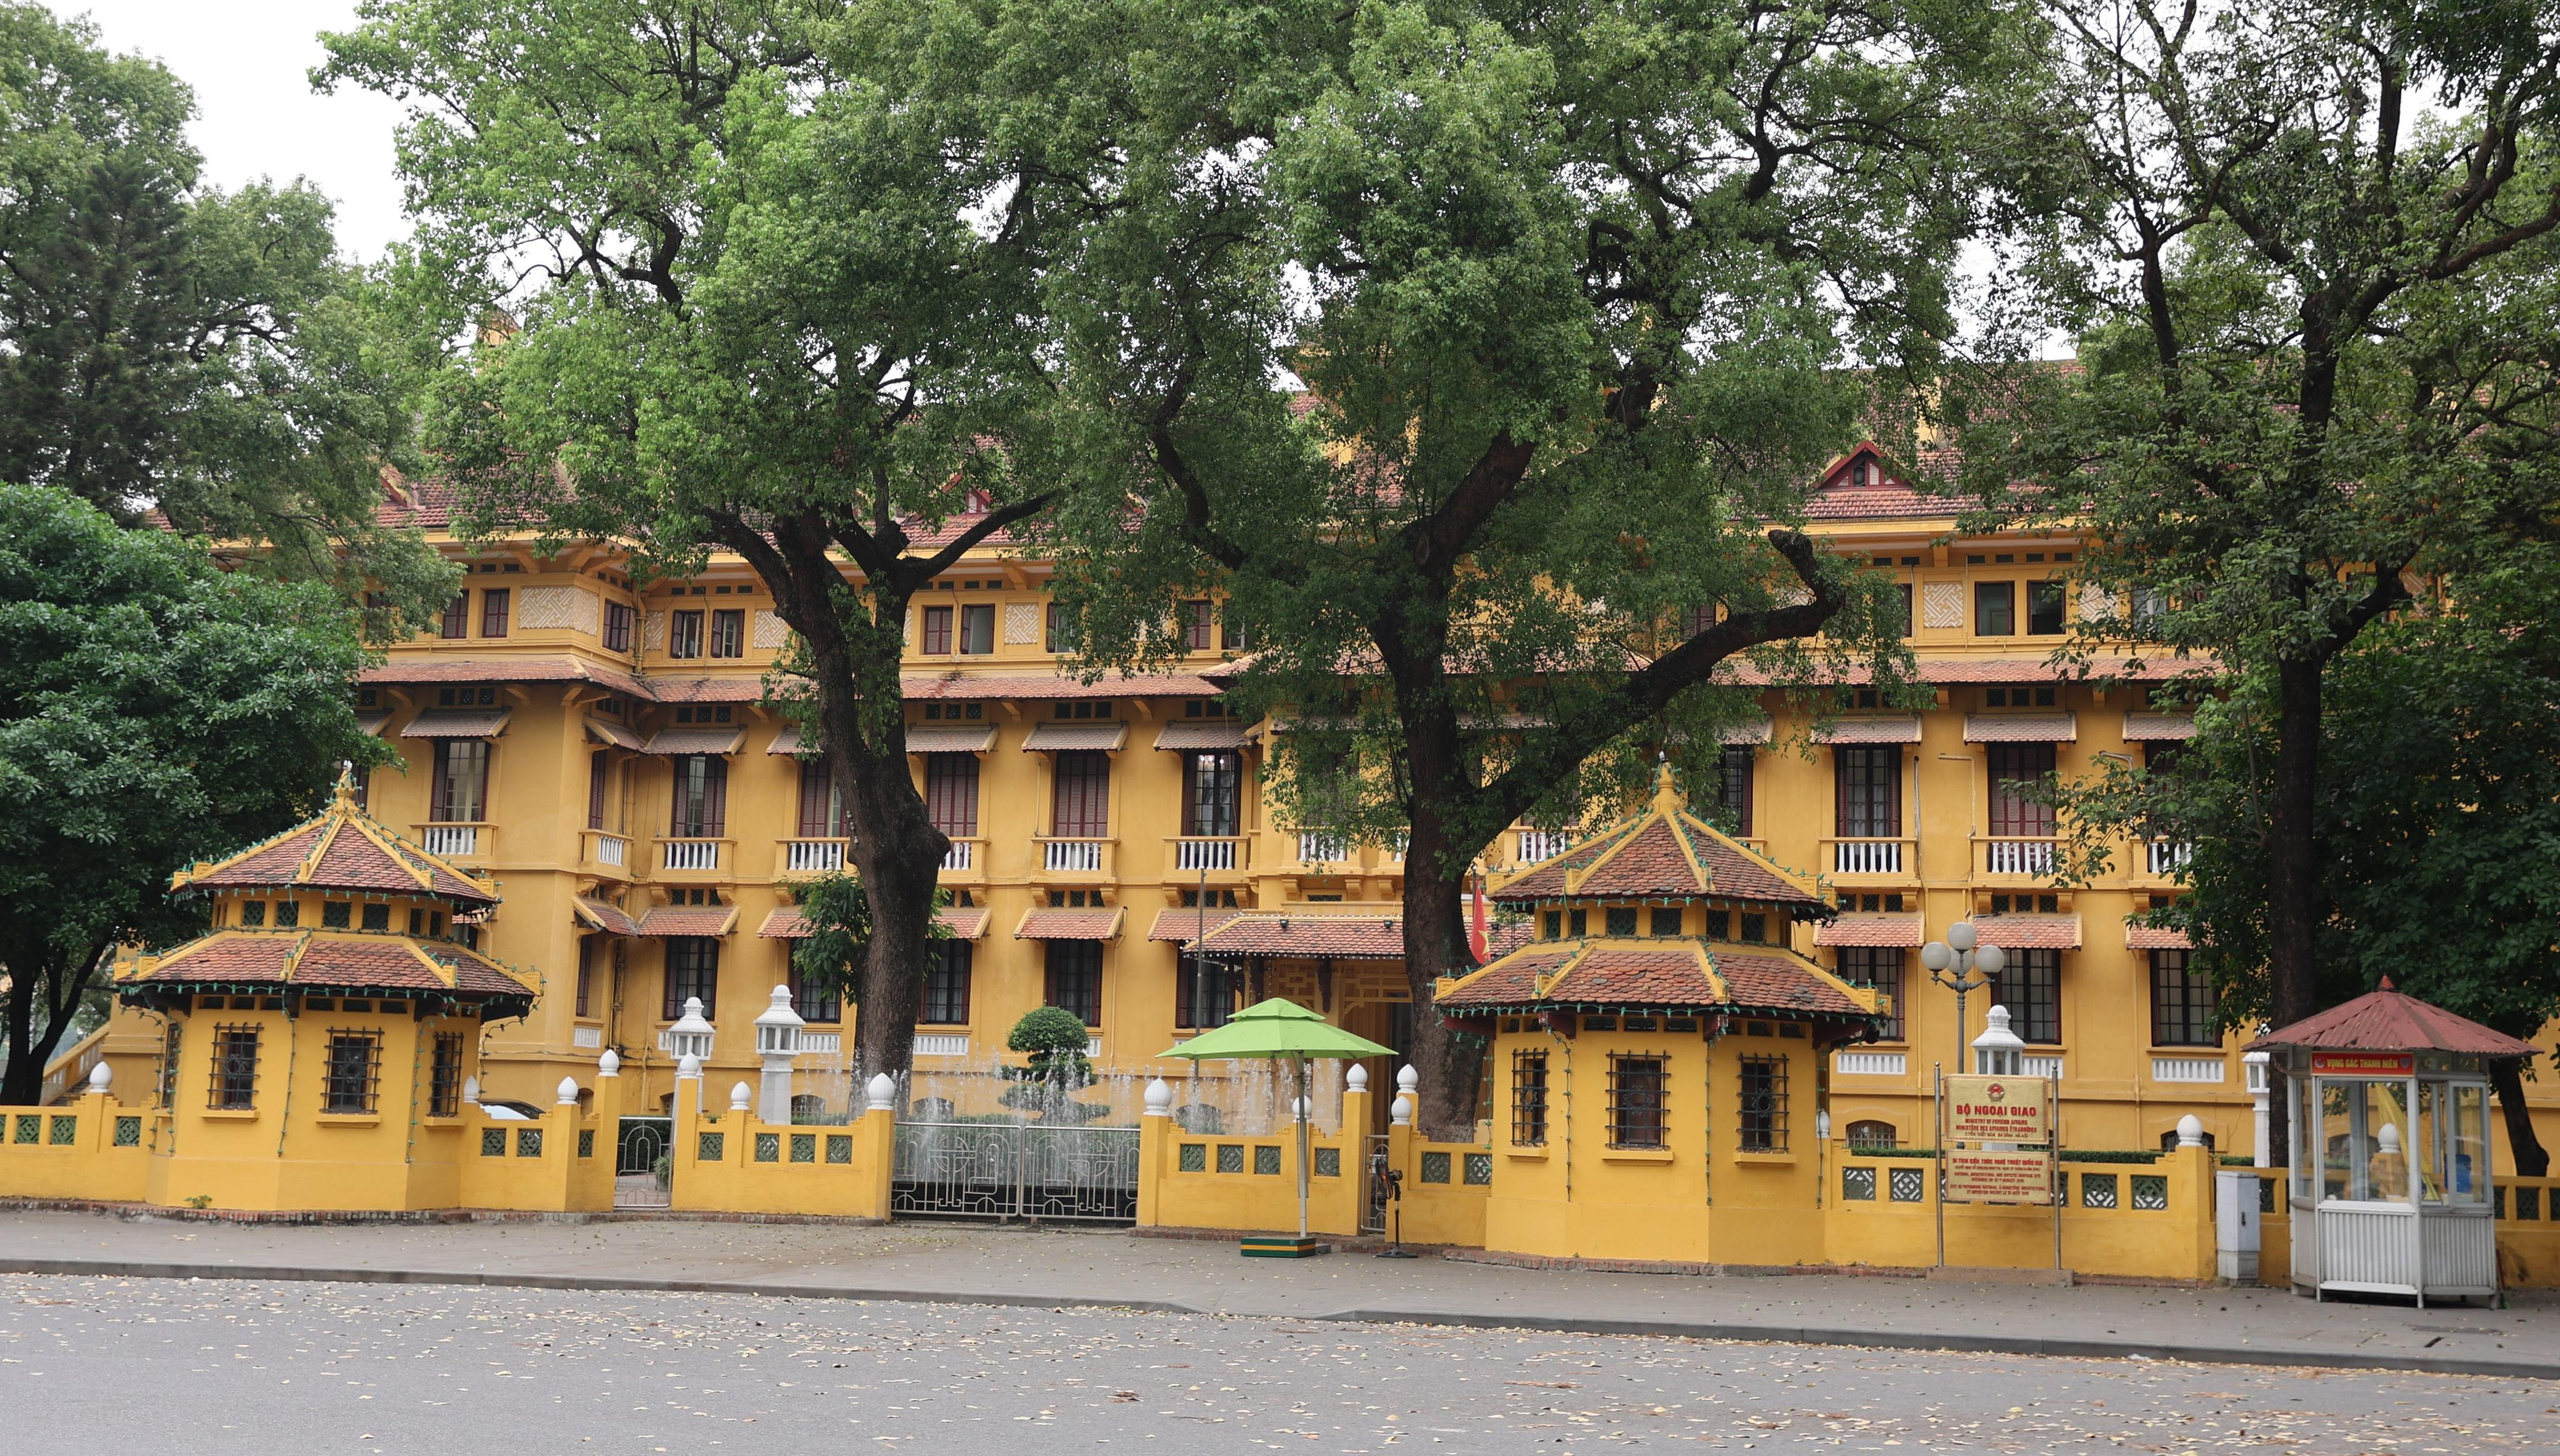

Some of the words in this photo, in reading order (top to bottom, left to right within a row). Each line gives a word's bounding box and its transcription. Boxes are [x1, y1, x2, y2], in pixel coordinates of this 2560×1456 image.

[2345, 1058, 2358, 1068] GÁC
[1956, 1103, 1970, 1117] BỘ
[1974, 1105, 2007, 1117] NGOẠI
[2011, 1106, 2036, 1117] GIAO
